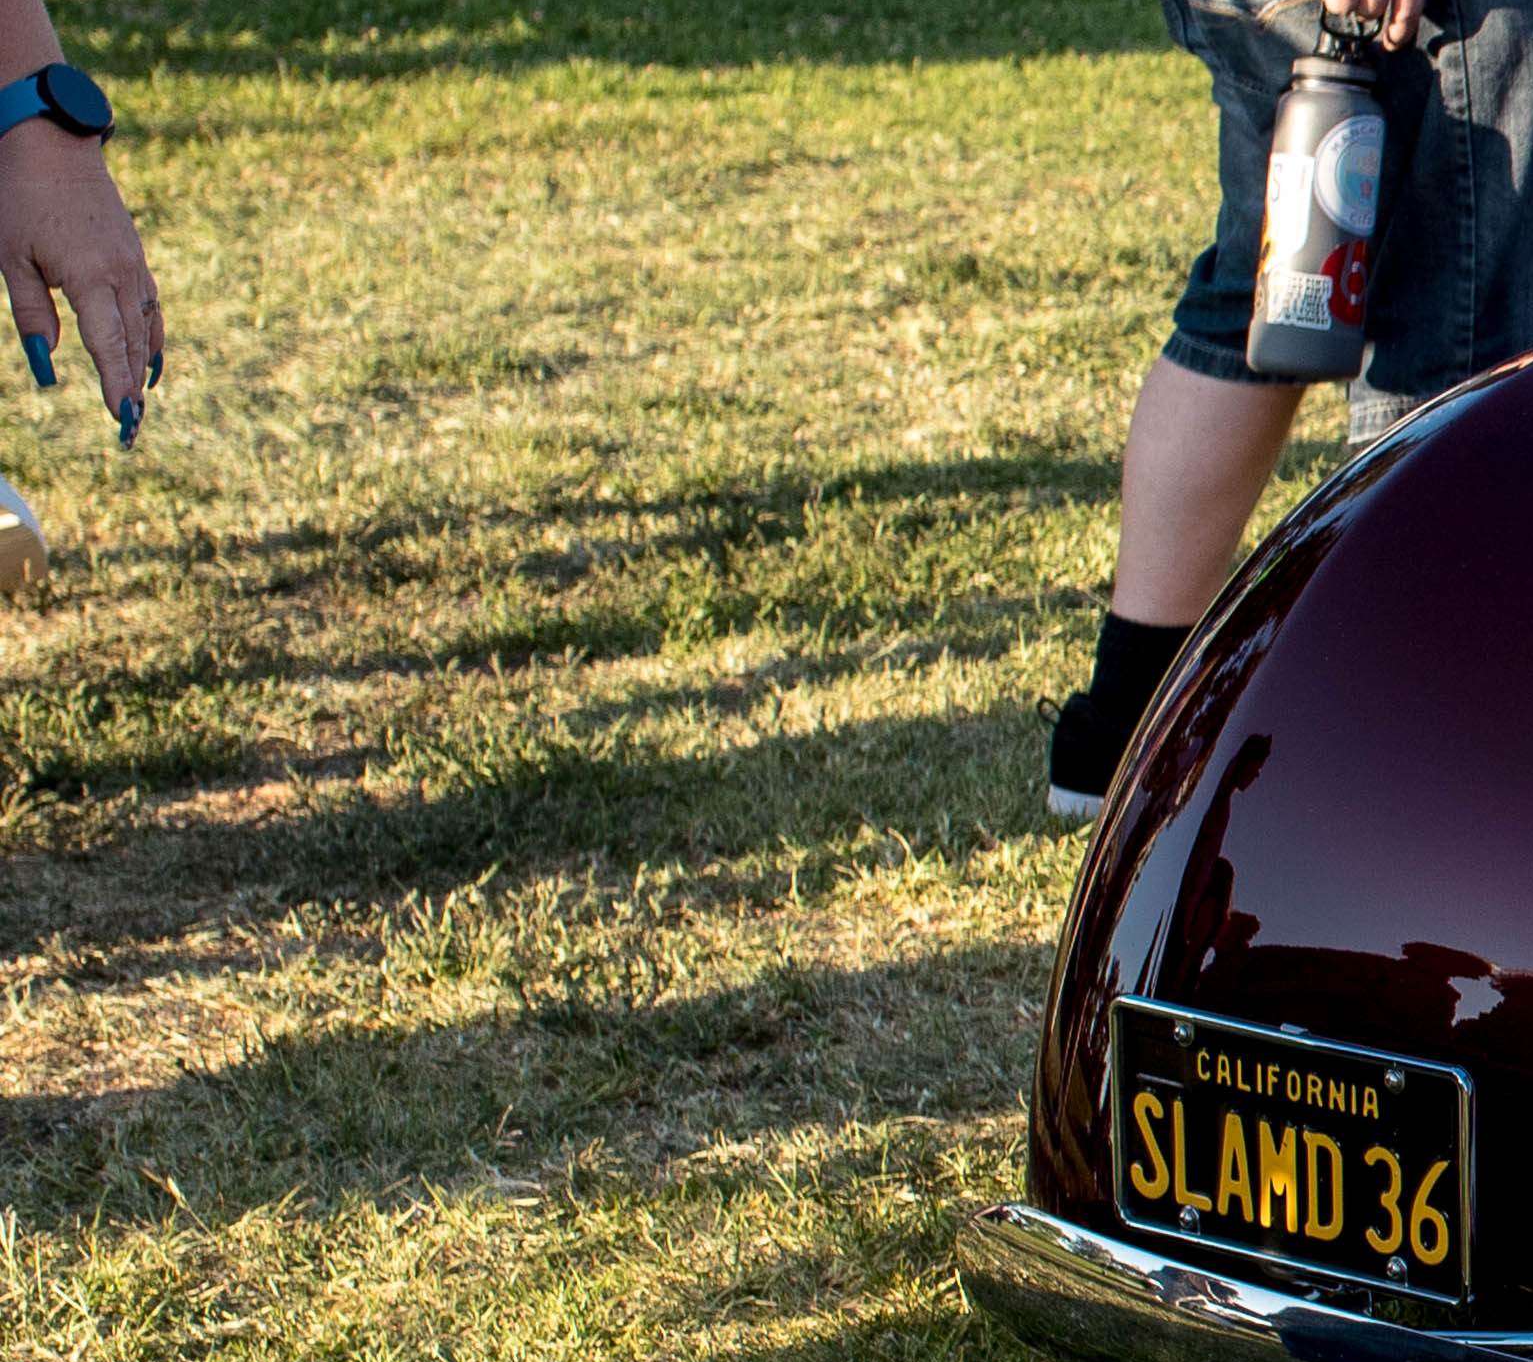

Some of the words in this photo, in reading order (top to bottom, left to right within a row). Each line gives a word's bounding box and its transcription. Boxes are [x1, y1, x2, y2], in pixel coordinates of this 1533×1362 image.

[1196, 1049, 1380, 1120] CALIFORNIA
[1130, 1091, 1344, 1241] SLAMD
[1363, 1145, 1451, 1266] 36
